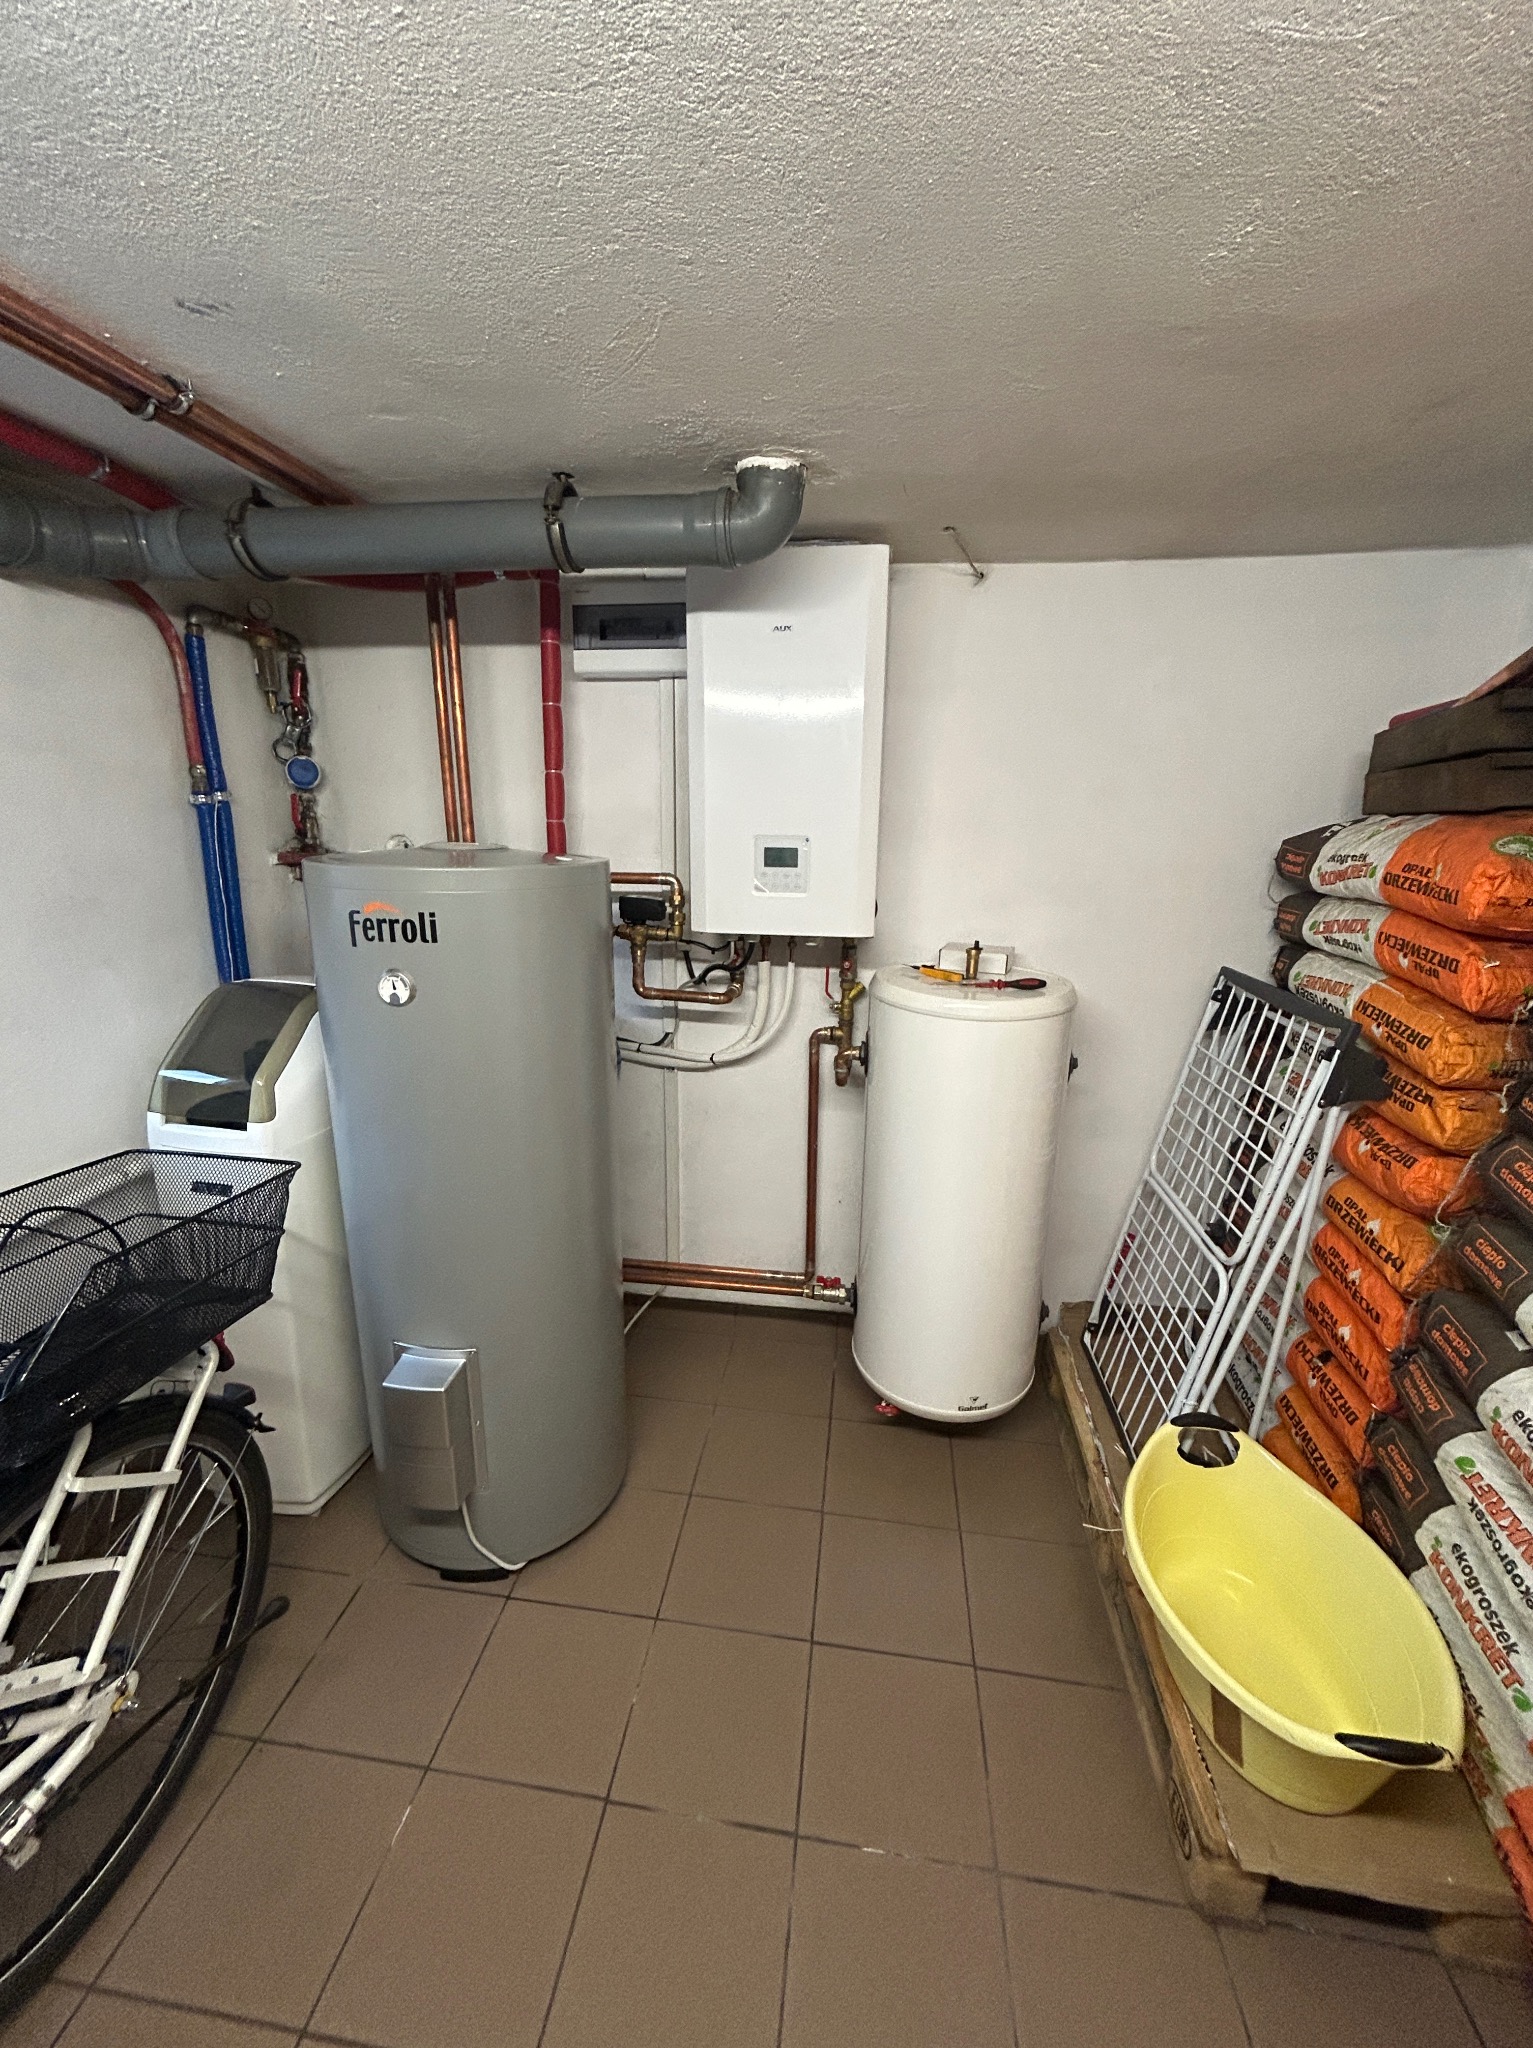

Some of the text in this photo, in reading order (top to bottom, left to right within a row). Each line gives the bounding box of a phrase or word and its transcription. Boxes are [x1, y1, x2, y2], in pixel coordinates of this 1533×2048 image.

[348, 909, 438, 947] Ferroli
[1428, 1550, 1525, 1690] KONKRET
[1451, 1542, 1520, 1659] ekogroszek
